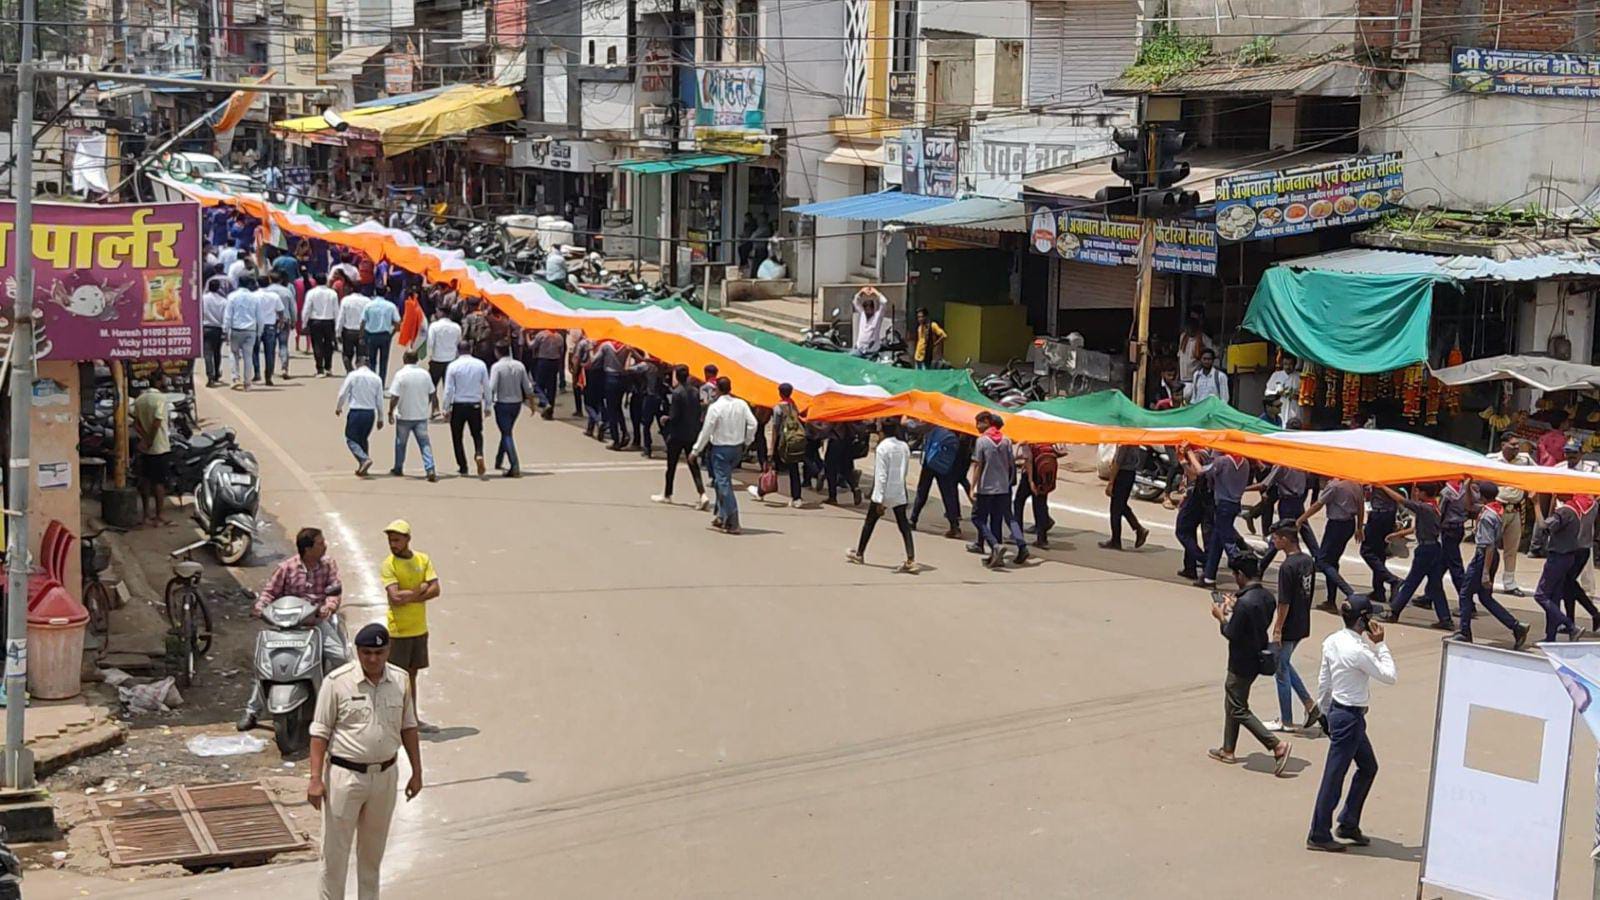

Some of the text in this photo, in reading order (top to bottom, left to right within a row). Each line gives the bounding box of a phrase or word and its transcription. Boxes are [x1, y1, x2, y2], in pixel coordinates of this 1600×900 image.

[1457, 49, 1481, 69] श्री
[1483, 56, 1549, 74] अग्रवाल
[983, 140, 1029, 180] पवन
[1216, 179, 1230, 200] श्री
[1232, 179, 1271, 199] अग्रवाल
[1273, 170, 1323, 193] भोजनालय
[31, 208, 183, 268] पार्लर
[1058, 211, 1069, 232] श्री
[1069, 217, 1099, 235] अग्रवाल
[1100, 213, 1141, 240] भोजनालय
[1188, 222, 1215, 246] सर्विस
[100, 329, 109, 337] M.
[112, 328, 141, 337] Haresh
[119, 338, 141, 348] Vicky
[110, 348, 141, 358] Akshay
